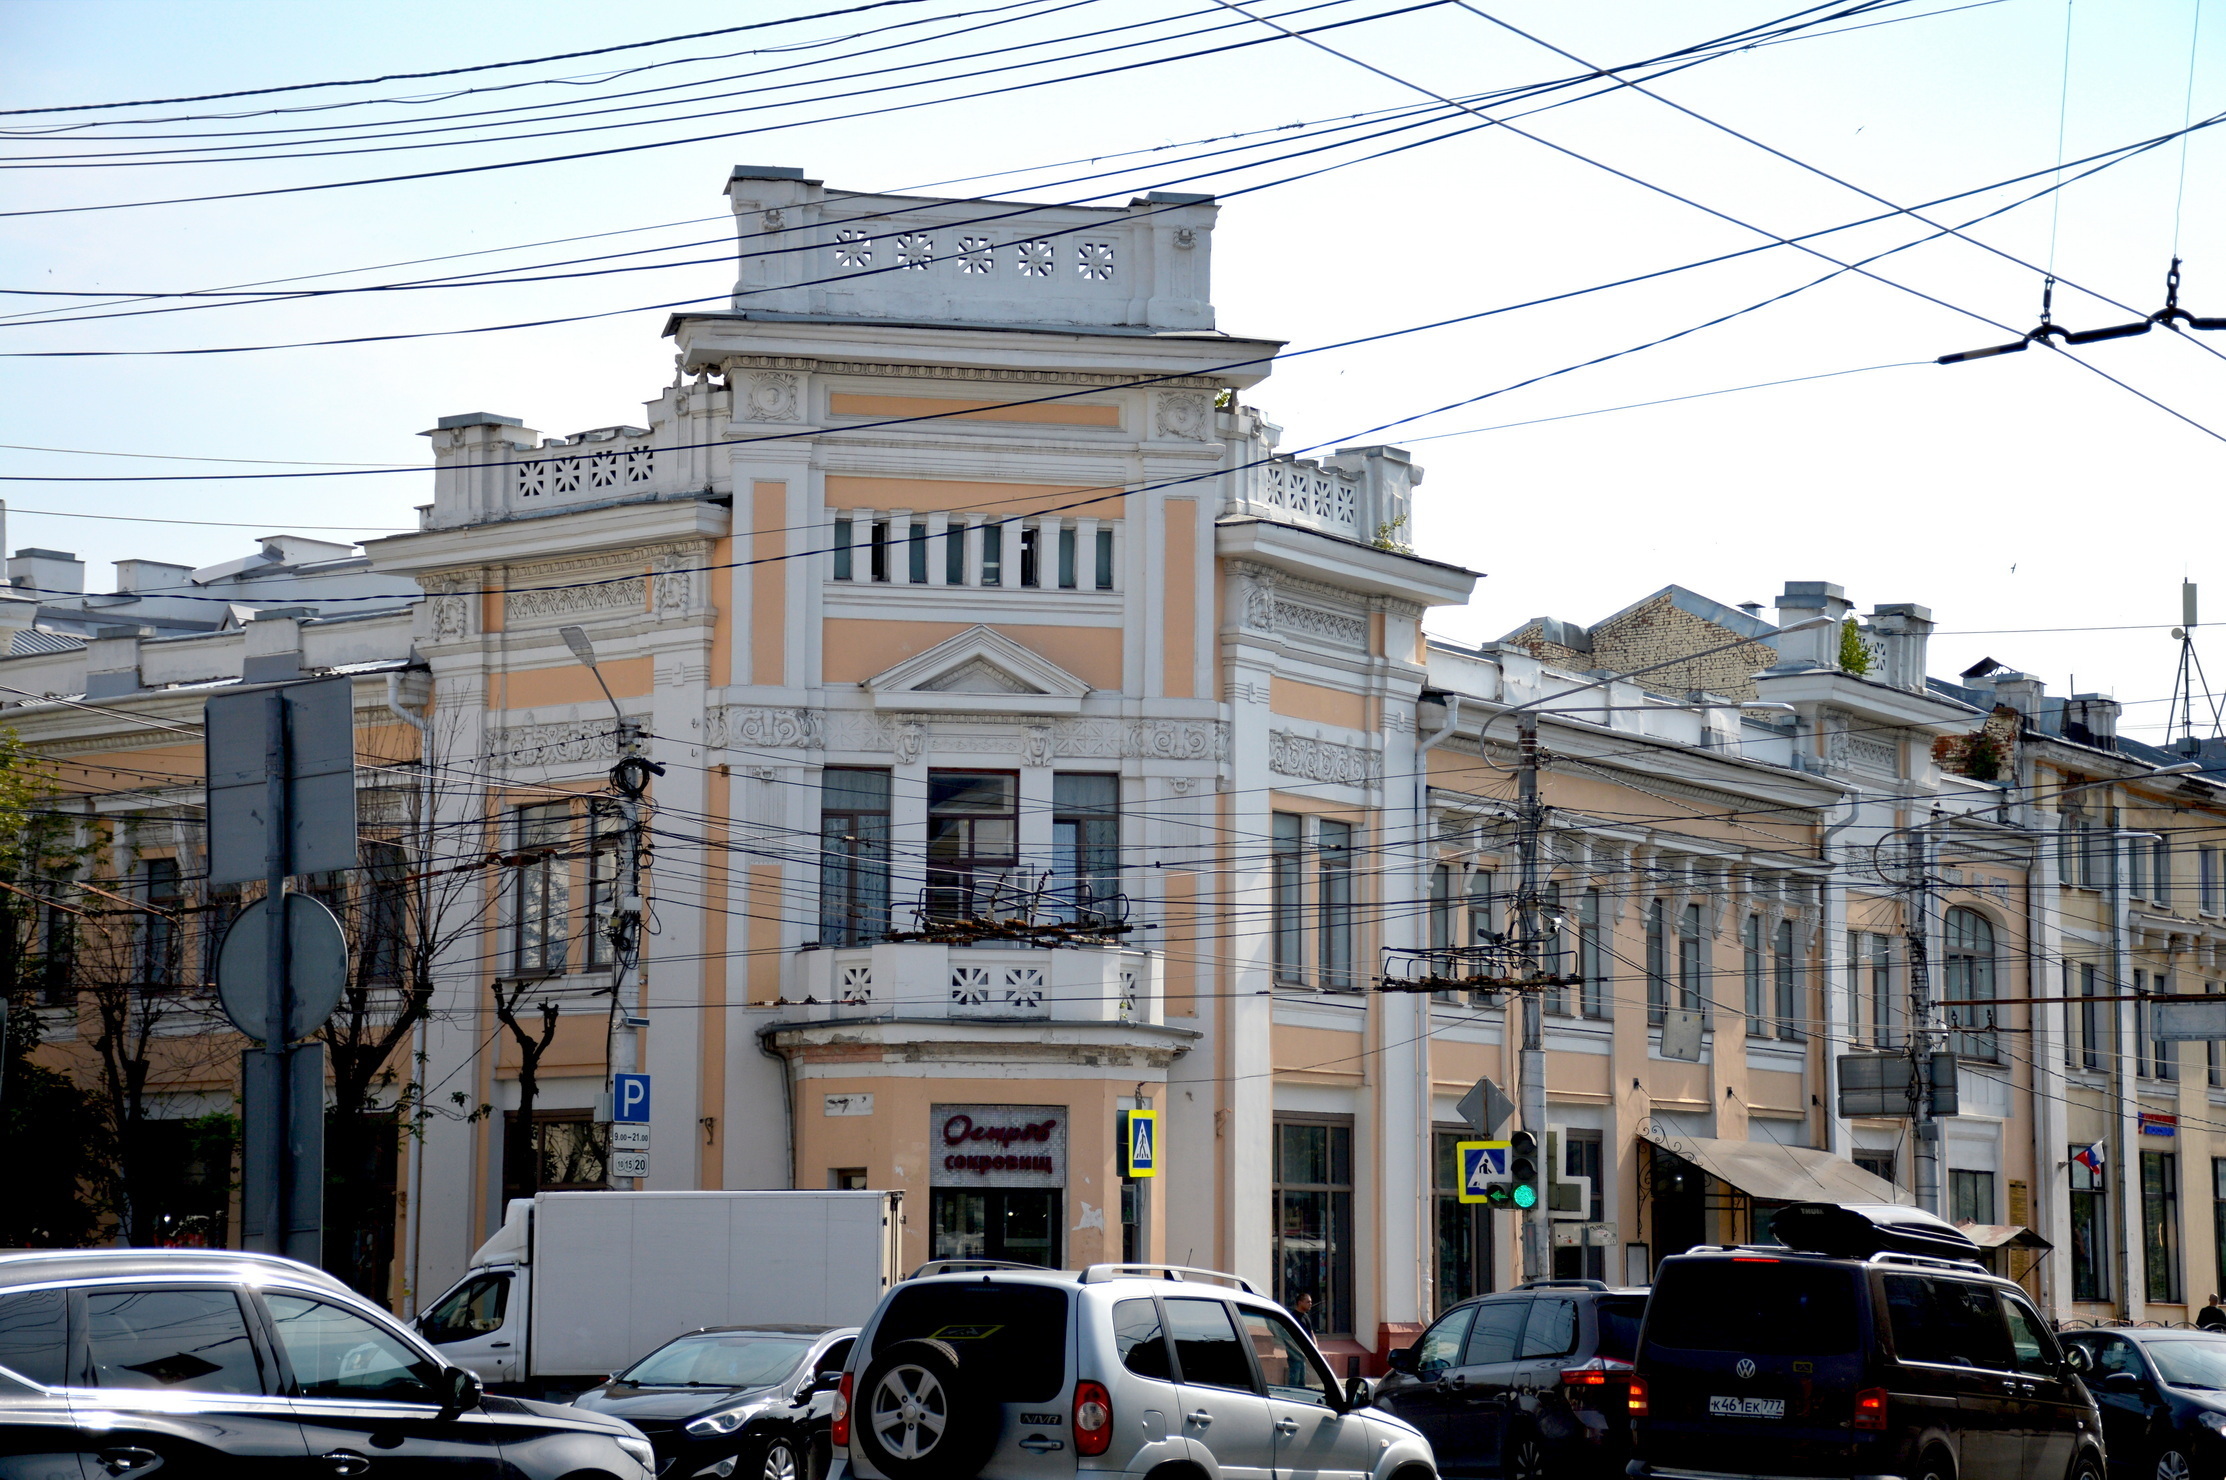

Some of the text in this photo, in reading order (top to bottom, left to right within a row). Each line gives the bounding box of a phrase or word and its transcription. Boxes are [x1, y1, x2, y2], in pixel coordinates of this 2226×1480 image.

[623, 1079, 644, 1117] P
[943, 1114, 1057, 1148] Остров
[625, 1159, 633, 1170] 15
[634, 1159, 645, 1170] 20
[944, 1154, 1053, 1175] сокровищ
[1763, 1400, 1781, 1410] 777
[1022, 1415, 1059, 1424] NIVA
